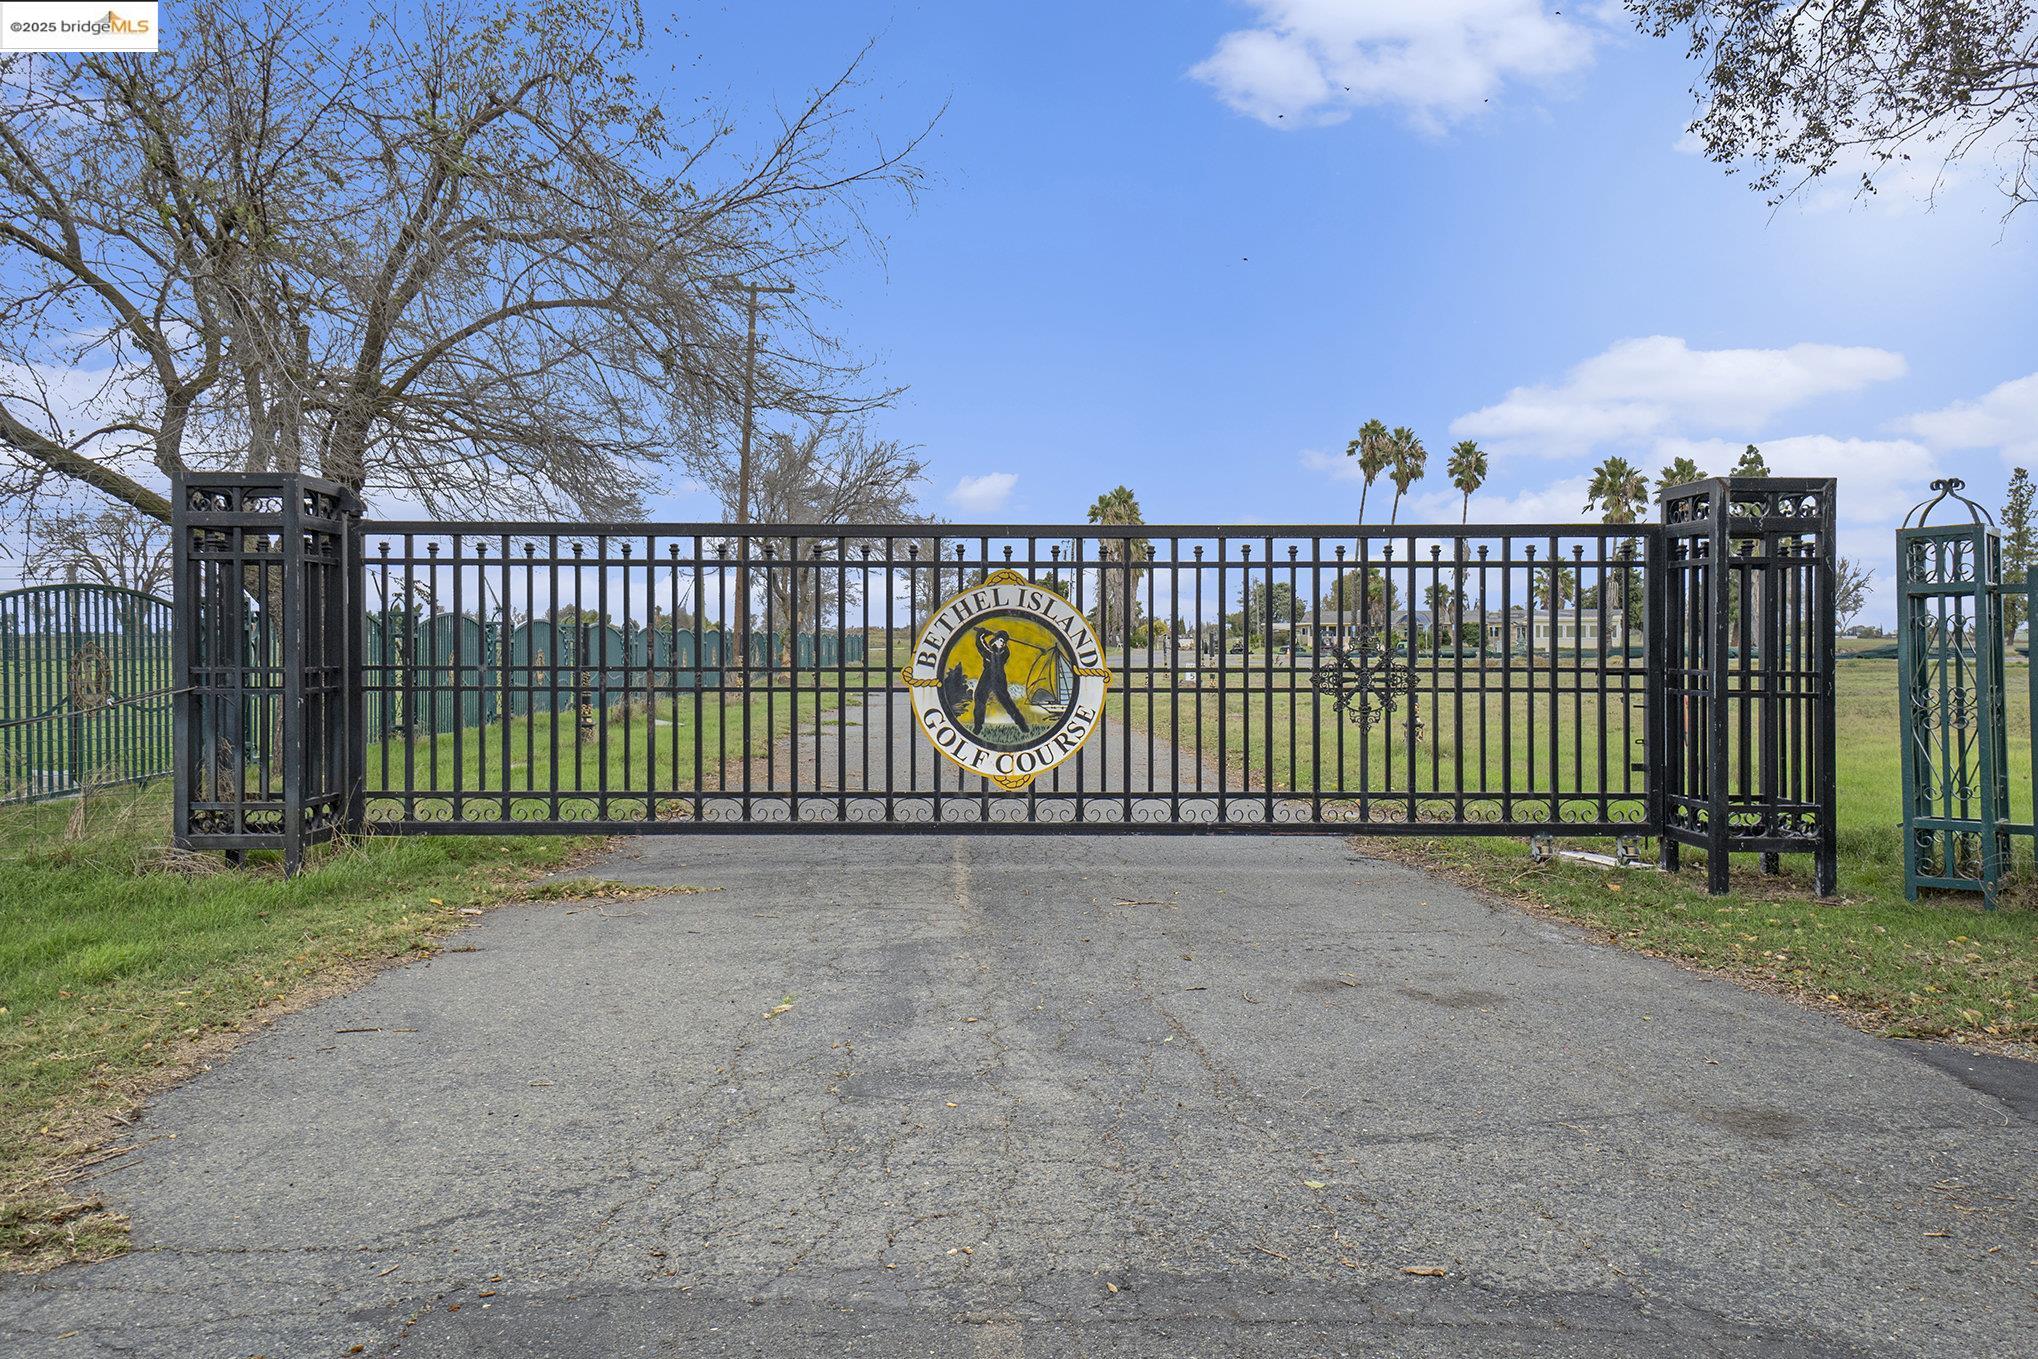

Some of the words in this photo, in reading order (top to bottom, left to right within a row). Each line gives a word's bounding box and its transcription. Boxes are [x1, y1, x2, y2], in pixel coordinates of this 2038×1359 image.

[916, 588, 1010, 670] BETHEL
[1018, 588, 1100, 668] ISLAND
[923, 708, 990, 769] GOLF
[995, 704, 1096, 774] COURSE
